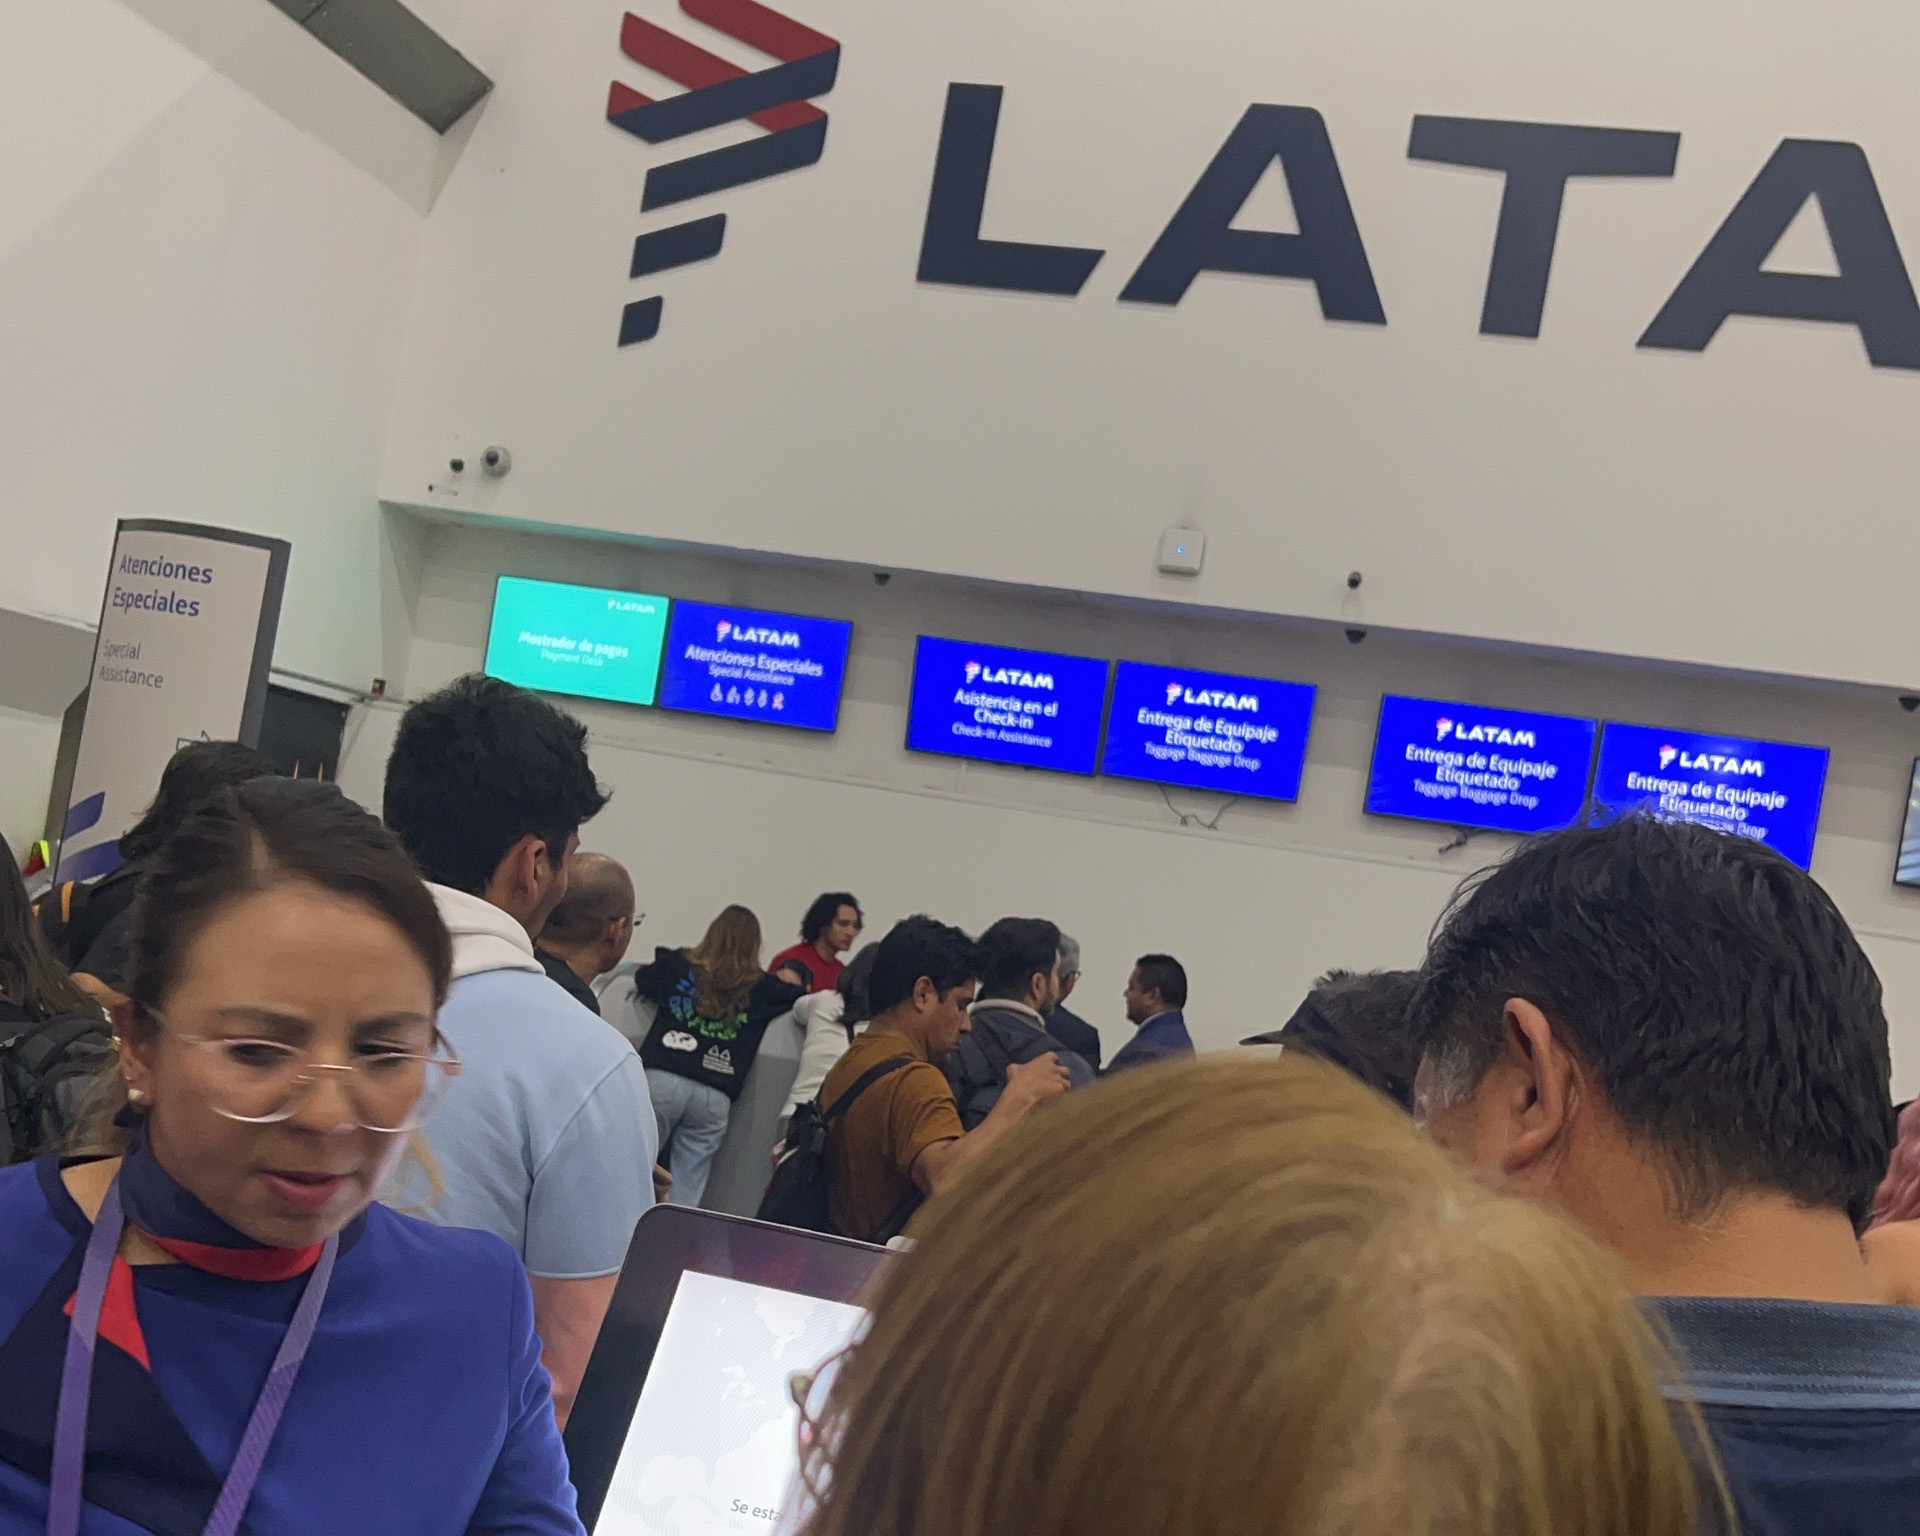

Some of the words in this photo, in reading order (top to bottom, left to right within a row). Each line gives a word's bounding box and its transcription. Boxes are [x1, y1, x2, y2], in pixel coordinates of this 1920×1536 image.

[916, 81, 1920, 371] LATA
[118, 553, 213, 584] Atenciones
[112, 587, 201, 617] Especiales
[616, 601, 655, 614] LATAM
[103, 639, 141, 661] Special
[519, 630, 577, 652] Mostrador
[578, 636, 597, 653] de
[598, 643, 628, 660] pagos
[732, 626, 800, 648] LATAM
[685, 644, 756, 669] Atenciones
[757, 652, 823, 677] Especiales
[99, 664, 164, 688] Assistance
[708, 664, 743, 682] Special
[744, 667, 795, 686] Assistance
[982, 666, 1054, 691] LATAM
[954, 688, 1022, 715] Asistencia
[1023, 702, 1042, 716] en
[1043, 701, 1058, 717] el
[1183, 687, 1259, 713] LATAM
[973, 708, 1034, 730] Check-in
[1137, 707, 1193, 734] Entrega
[1194, 716, 1213, 734] de
[1214, 718, 1280, 744] Equipaje
[952, 722, 996, 742] Check-in
[997, 726, 1052, 748] Assistance
[1165, 729, 1244, 754] Etiquetado
[1455, 722, 1536, 748] LATAM
[1187, 746, 1232, 768] Baggage
[1233, 752, 1262, 771] Drop
[1405, 744, 1465, 770] Entrega
[1466, 752, 1487, 770] de
[1488, 754, 1558, 780] Equipaje
[1679, 750, 1764, 777] LATAM
[1435, 765, 1520, 791] Etiquetado
[1460, 783, 1508, 805] Baggage
[1509, 790, 1540, 810] Drop
[1627, 772, 1687, 798] Entrega
[1688, 780, 1712, 799] de
[1714, 783, 1786, 811] Equipaje
[1659, 794, 1747, 822] Etiquetado
[1736, 815, 1768, 838] Drop
[730, 1498, 749, 1514] Se
